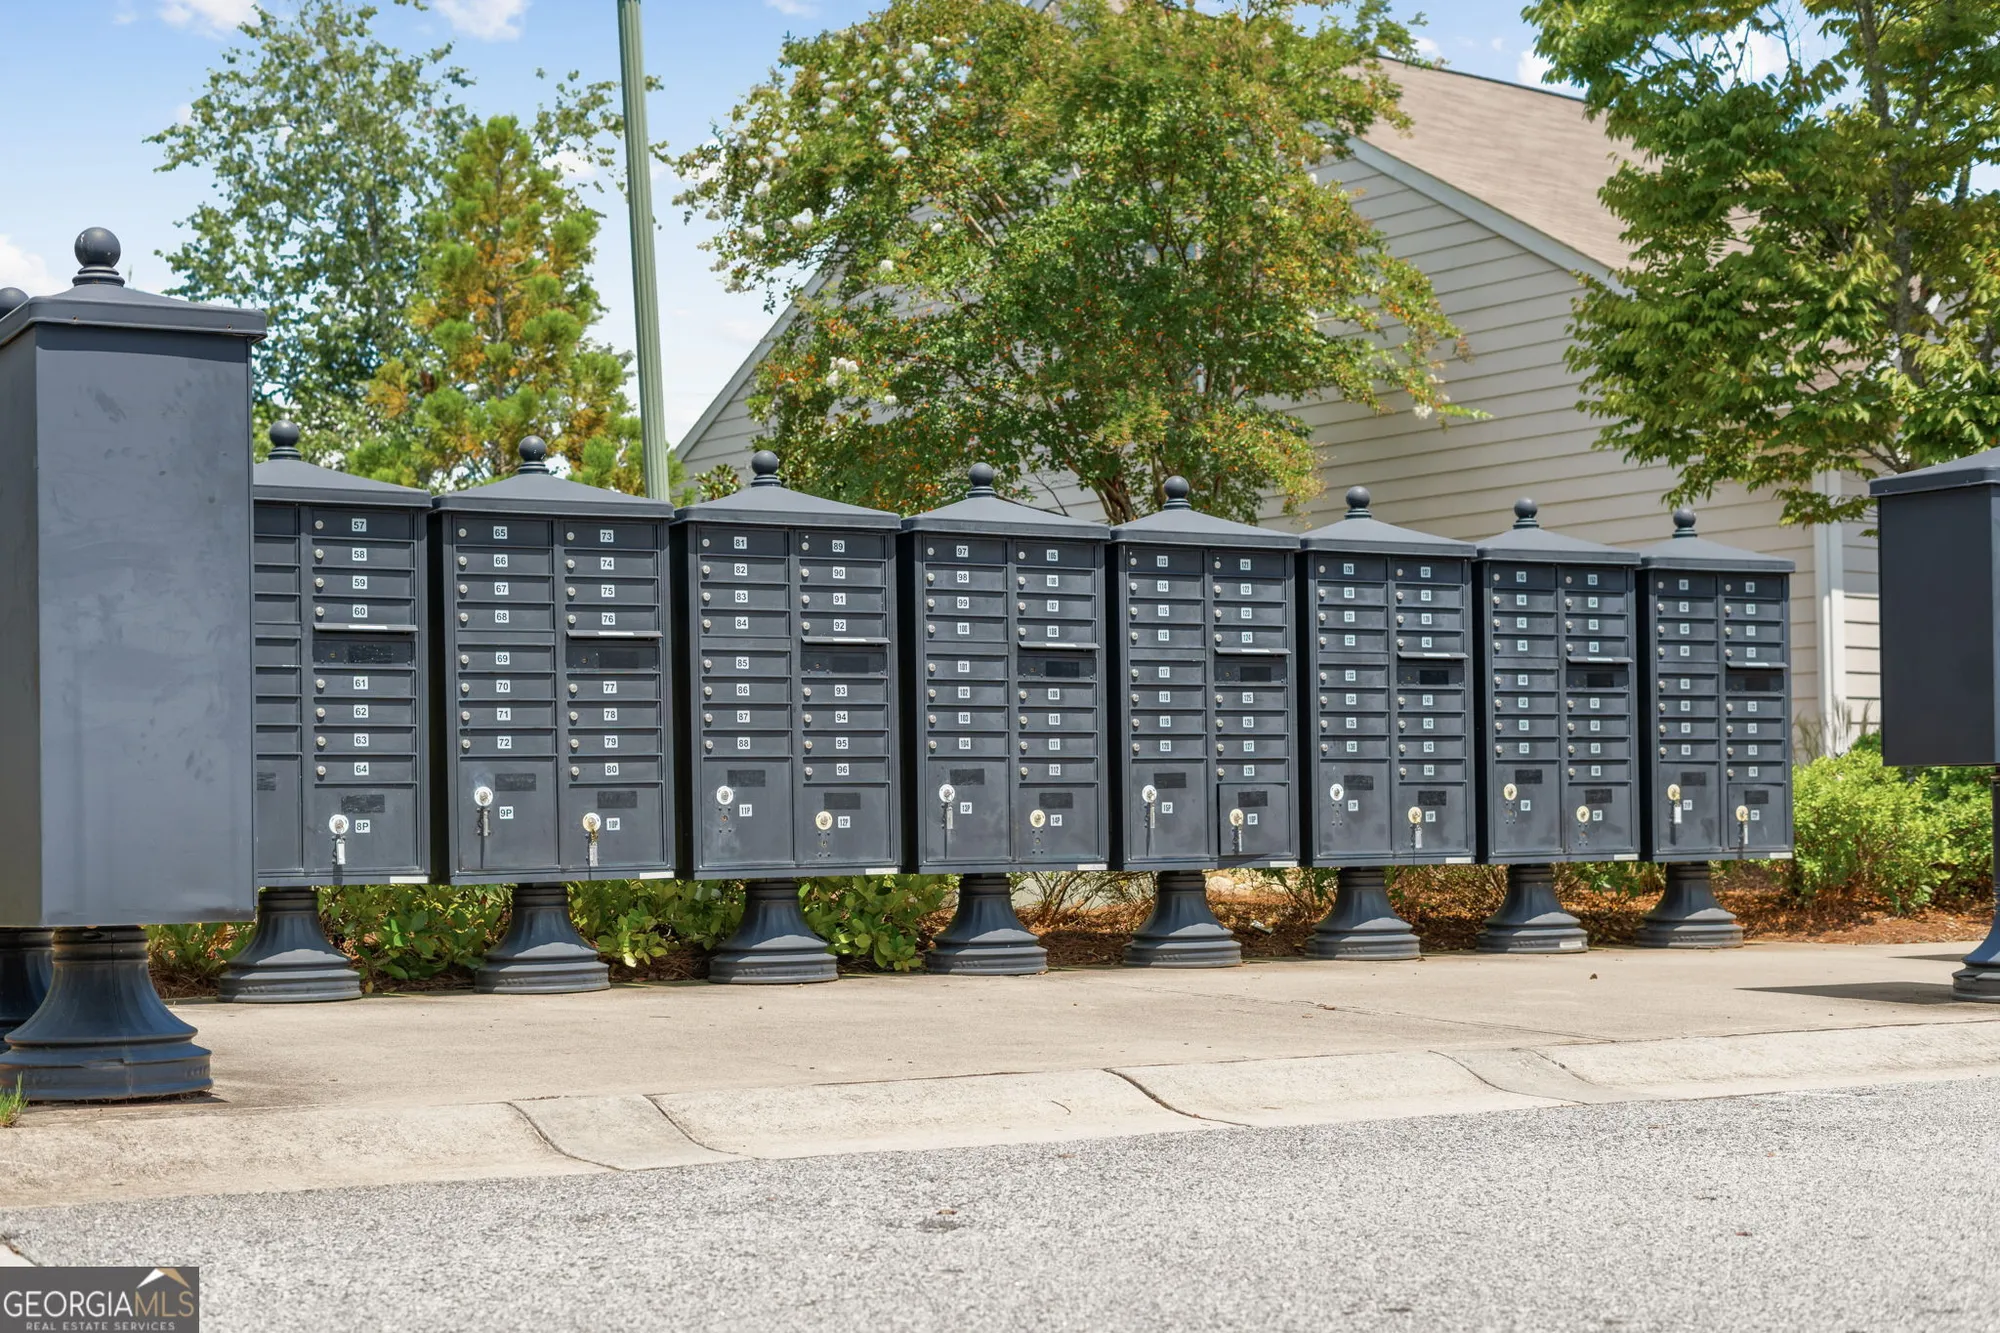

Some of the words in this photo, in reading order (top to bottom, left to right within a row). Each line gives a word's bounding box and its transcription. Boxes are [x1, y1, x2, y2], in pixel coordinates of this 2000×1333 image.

[353, 520, 365, 530] 57
[494, 528, 506, 537] 65
[602, 532, 612, 541] 73
[735, 538, 745, 547] 81
[833, 542, 844, 551] 89
[353, 550, 365, 559] 58
[957, 547, 967, 556] 97
[1048, 551, 1057, 560] 105
[495, 556, 507, 565] 66
[602, 559, 613, 568] 74
[1158, 557, 1167, 566] 113
[735, 565, 746, 574] 82
[834, 568, 844, 577] 90
[958, 573, 968, 581] 98
[354, 578, 366, 587] 59
[495, 584, 507, 593] 67
[603, 587, 614, 596] 75
[736, 592, 747, 601] 83
[834, 595, 844, 603] 91
[958, 598, 968, 607] 99
[354, 607, 366, 616] 60
[1159, 607, 1168, 615] 115
[496, 612, 508, 621] 68
[603, 614, 614, 623] 76
[736, 619, 747, 627] 84
[834, 621, 845, 630] 92
[1243, 633, 1251, 642] 124
[497, 654, 508, 663] 69
[737, 658, 748, 668] 85
[959, 663, 968, 671] 101
[355, 678, 366, 688] 61
[498, 682, 509, 691] 70
[604, 683, 615, 692] 77
[737, 685, 748, 694] 86
[835, 686, 846, 695] 93
[355, 707, 367, 716] 62
[498, 710, 509, 719] 71
[605, 710, 616, 719] 78
[738, 712, 748, 721] 87
[836, 713, 847, 722] 94
[355, 735, 367, 745] 63
[499, 738, 510, 747] 72
[606, 737, 617, 746] 79
[738, 739, 749, 748] 88
[836, 739, 847, 748] 95
[960, 739, 969, 748] 104
[1050, 740, 1059, 749] 111
[1245, 742, 1253, 750] 127
[355, 764, 367, 774] 64
[606, 765, 617, 774] 80
[837, 765, 848, 774] 96
[1050, 766, 1059, 774] 112
[741, 806, 751, 815] 11P
[962, 804, 971, 812] 13P
[1163, 804, 1171, 812] 15P
[500, 808, 512, 818] 9P
[839, 818, 849, 827] 12P
[1052, 816, 1061, 824] 14P
[356, 822, 369, 831] 8P
